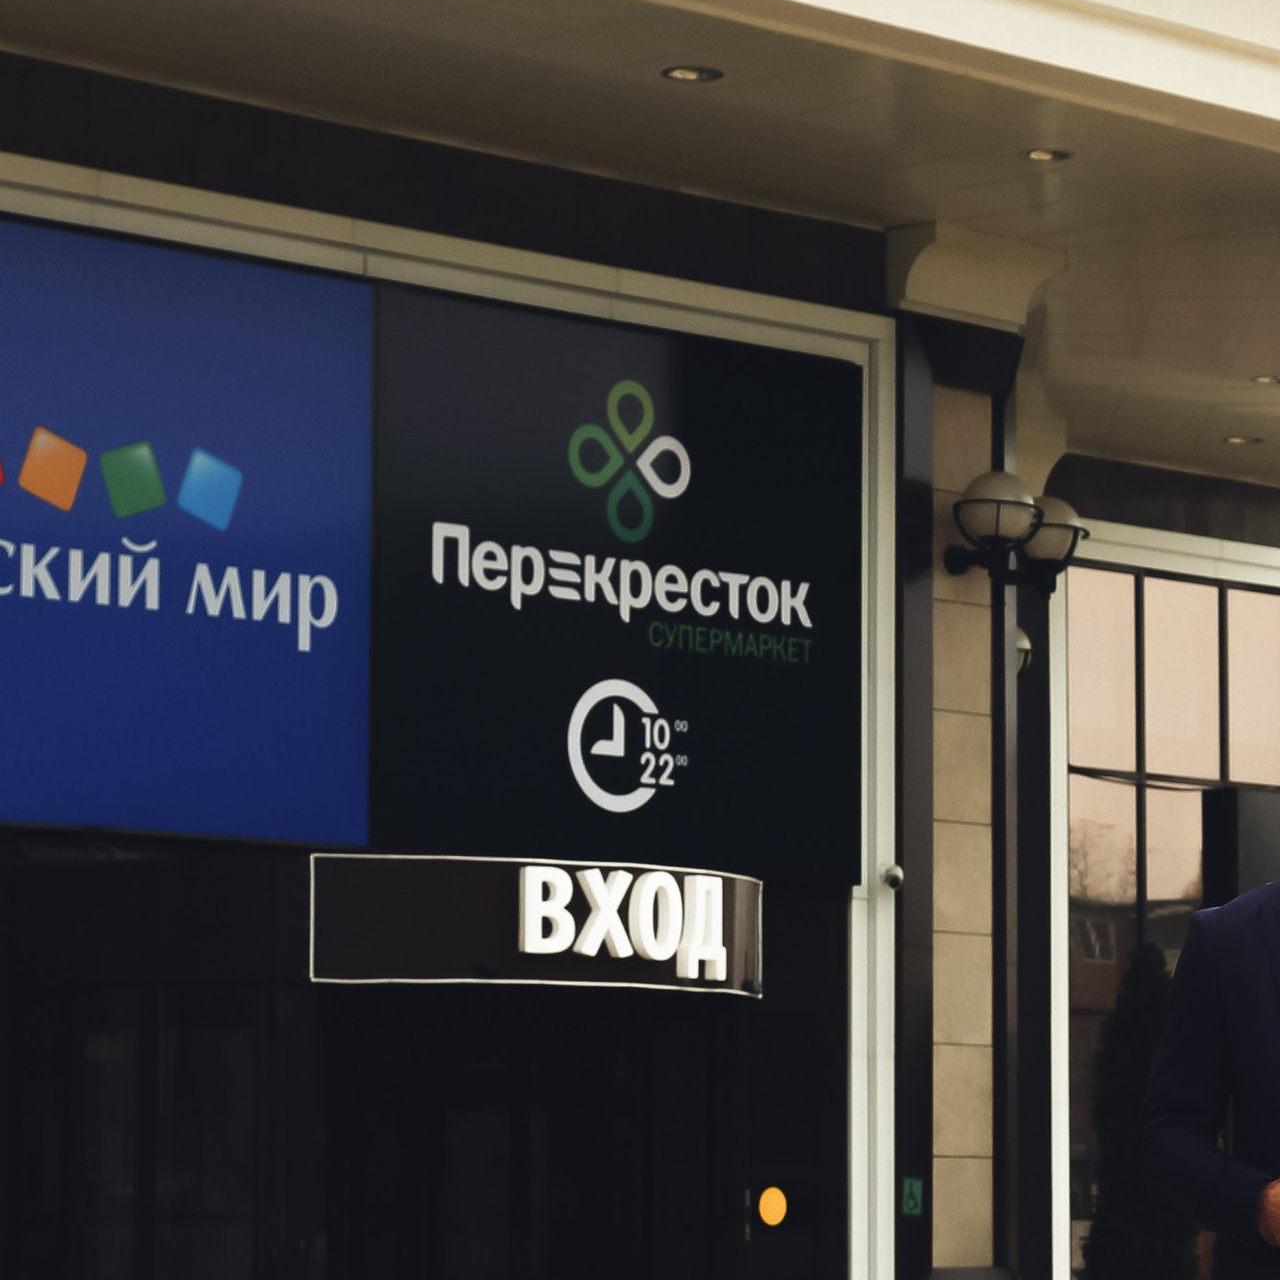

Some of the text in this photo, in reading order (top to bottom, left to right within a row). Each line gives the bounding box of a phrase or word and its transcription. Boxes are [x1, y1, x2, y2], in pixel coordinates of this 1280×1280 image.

[185, 562, 339, 653] мир
[648, 621, 812, 664] СУПЕРМАРКЕТ
[518, 865, 727, 981] ВХОД
